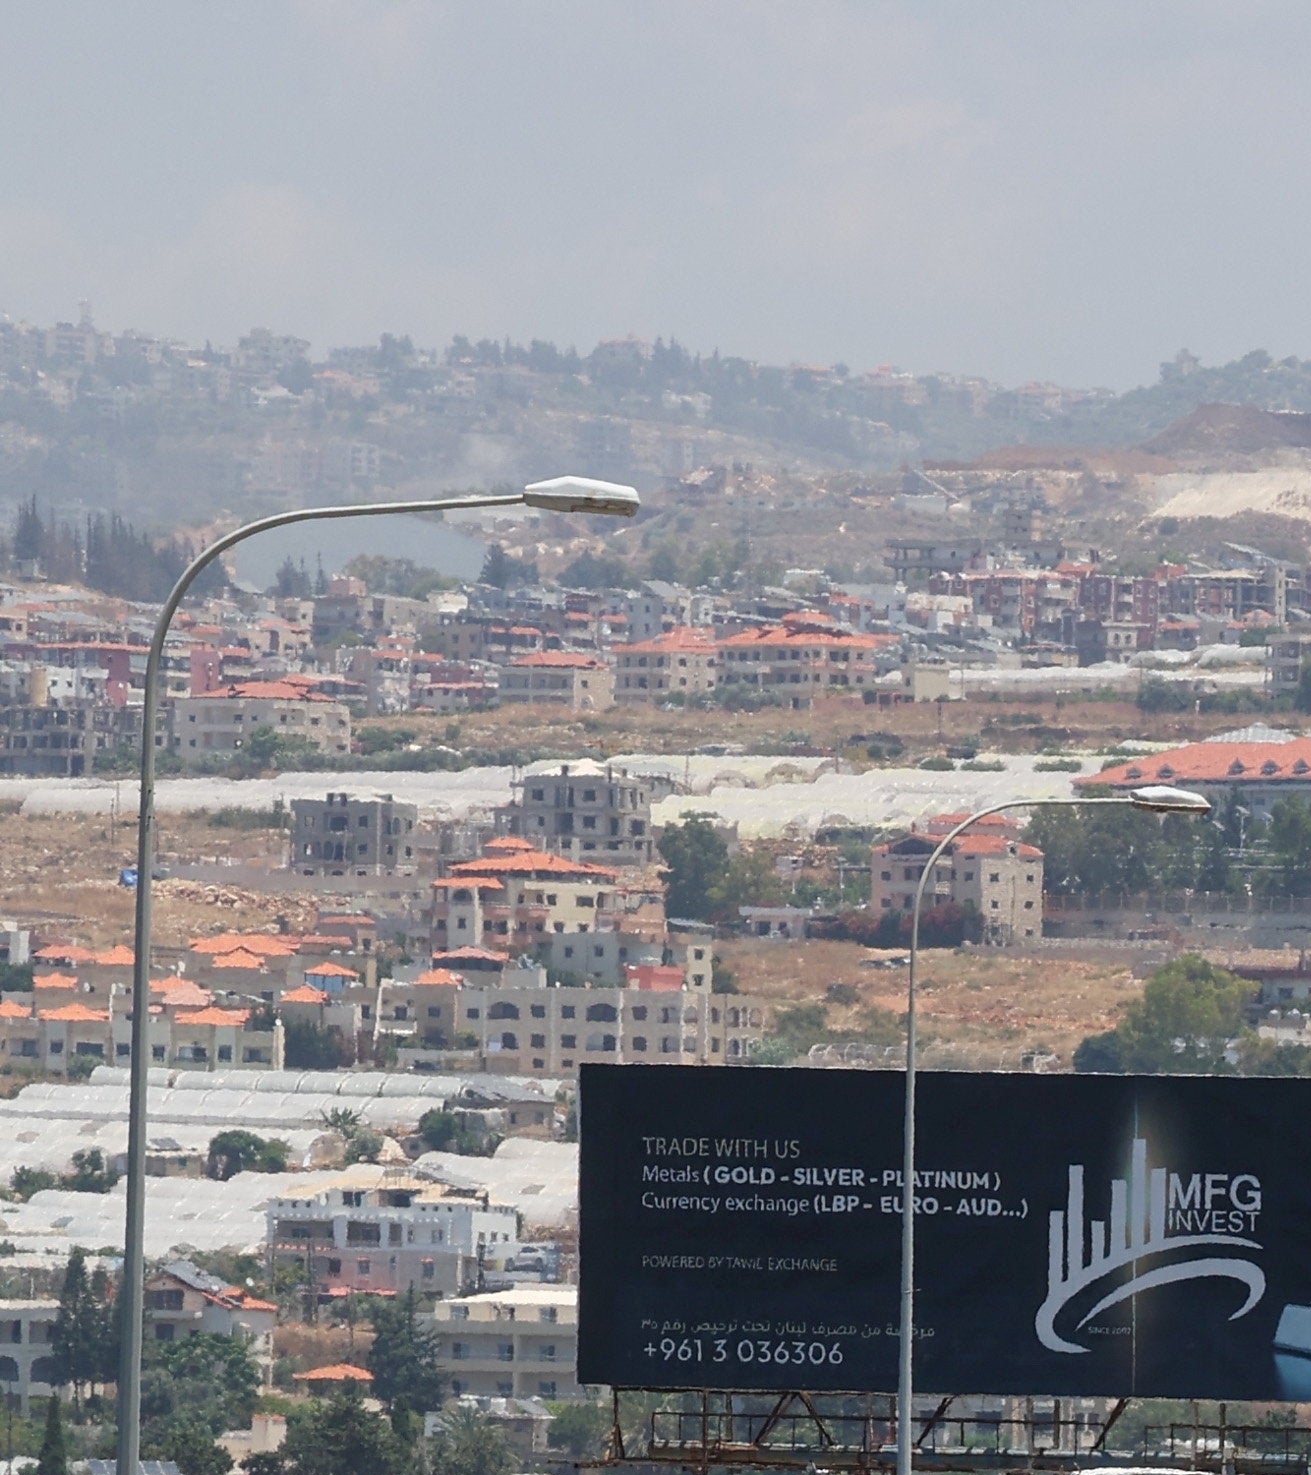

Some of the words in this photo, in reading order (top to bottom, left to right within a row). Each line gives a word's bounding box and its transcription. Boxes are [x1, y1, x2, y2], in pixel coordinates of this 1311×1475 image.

[642, 1137, 710, 1157] TRADE
[714, 1139, 768, 1158] WITH
[774, 1140, 801, 1159] US
[642, 1165, 700, 1183] Metals
[792, 1167, 866, 1187] SILVER
[1168, 1172, 1262, 1211] MFG
[641, 1192, 720, 1214] Currency
[725, 1195, 810, 1217] exchange
[1168, 1209, 1261, 1232] INVEST
[642, 1255, 705, 1269] POWERED
[708, 1257, 725, 1269] BY
[768, 1257, 838, 1272] EXCHANGE
[643, 1338, 702, 1362] +961
[712, 1339, 728, 1362] 3
[737, 1339, 844, 1365] 036306
